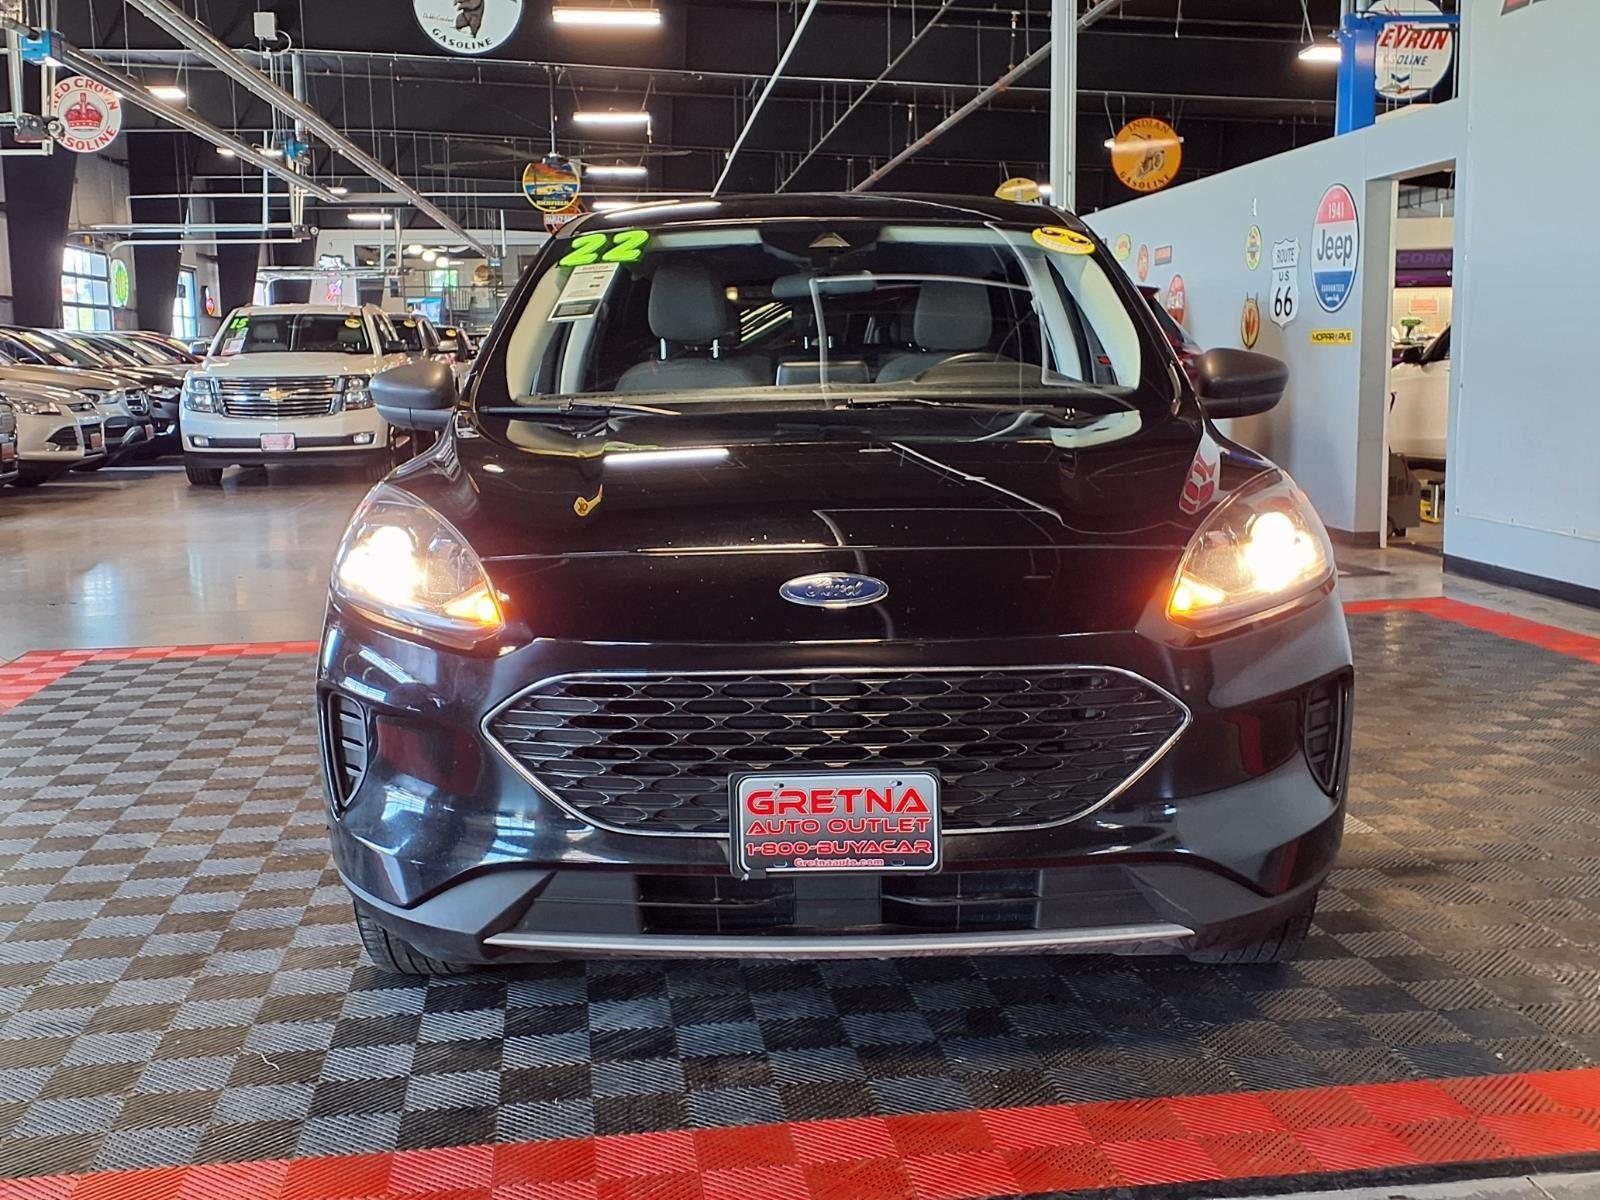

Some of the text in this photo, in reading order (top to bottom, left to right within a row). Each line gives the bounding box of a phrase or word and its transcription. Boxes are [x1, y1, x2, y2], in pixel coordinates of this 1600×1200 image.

[432, 27, 493, 49] GASOLINE
[1127, 120, 1169, 134] INDIAN
[1328, 201, 1345, 219] 1941
[558, 229, 650, 267] 22
[1276, 247, 1295, 262] ROUTE
[1317, 229, 1353, 266] Jeep
[1278, 270, 1290, 282] US
[1274, 286, 1293, 317] 66
[230, 317, 250, 329] 15
[805, 577, 864, 598] Ford
[747, 787, 931, 815] GRETNA
[746, 816, 933, 836] AUTO OUTLET
[745, 839, 932, 857] 1-800-BUYACAR
[793, 857, 885, 868] Gretnaauto.com
